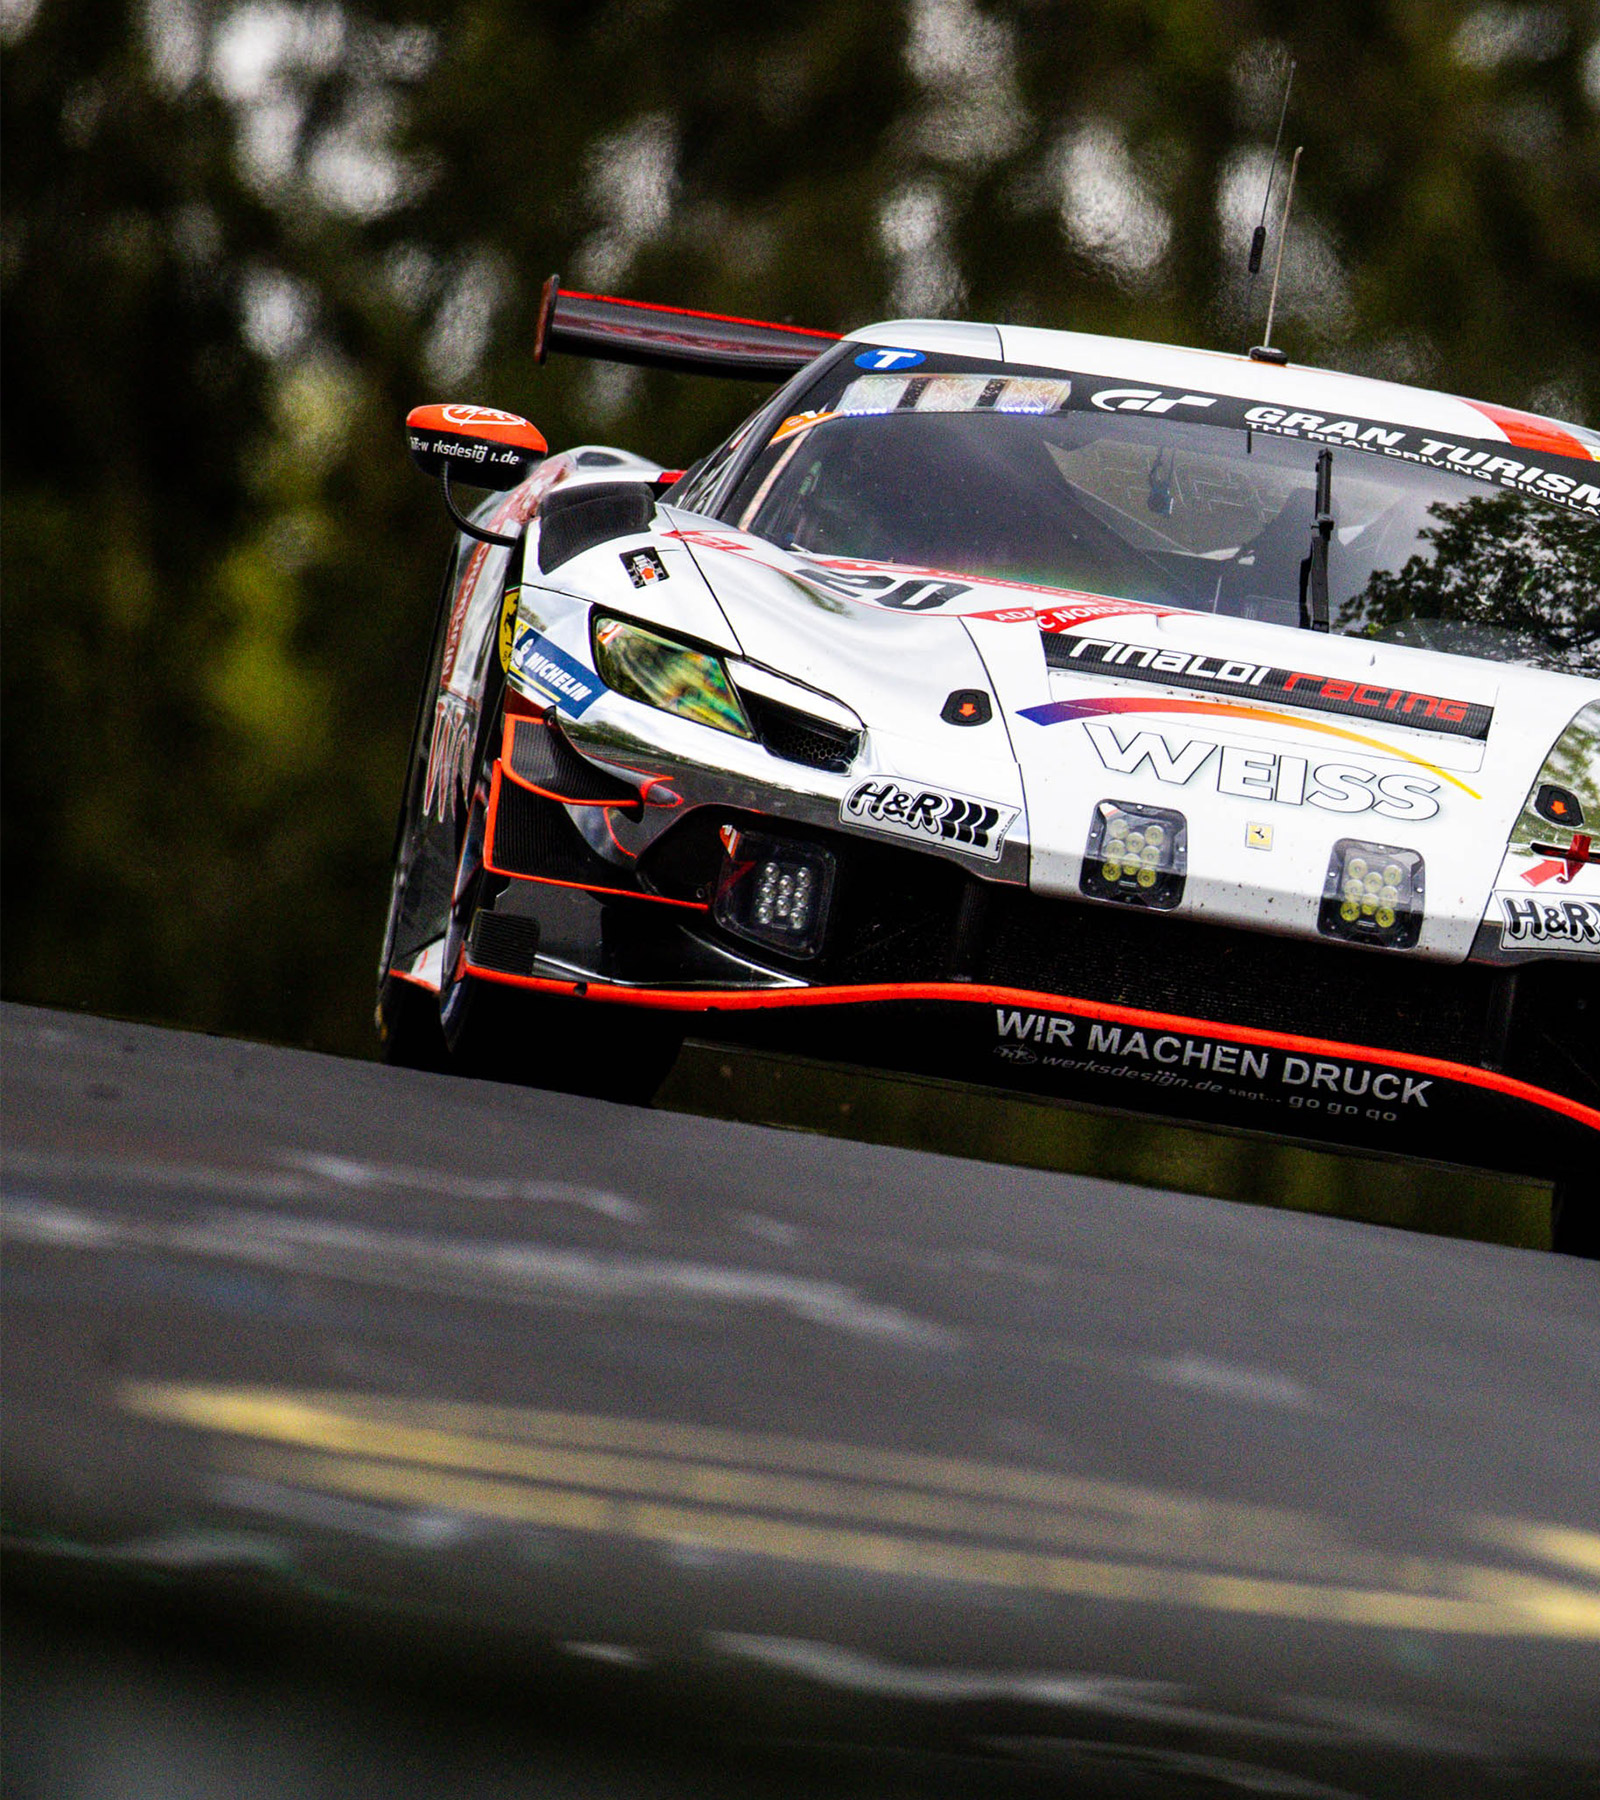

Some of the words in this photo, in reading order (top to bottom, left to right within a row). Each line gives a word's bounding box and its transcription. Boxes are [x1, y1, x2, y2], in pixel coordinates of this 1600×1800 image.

[873, 350, 917, 368] T
[1244, 406, 1405, 448] GRAN
[1246, 421, 1299, 437] THE
[1307, 431, 1377, 452] REAL
[1384, 448, 1493, 482] DRIVING
[525, 652, 592, 702] MICHELIN
[1082, 722, 1440, 822] WEISS
[849, 782, 949, 834] H&R
[996, 1009, 1076, 1047] WIR
[1087, 1024, 1269, 1080] MACHEN
[1282, 1057, 1433, 1108] DRUCK
